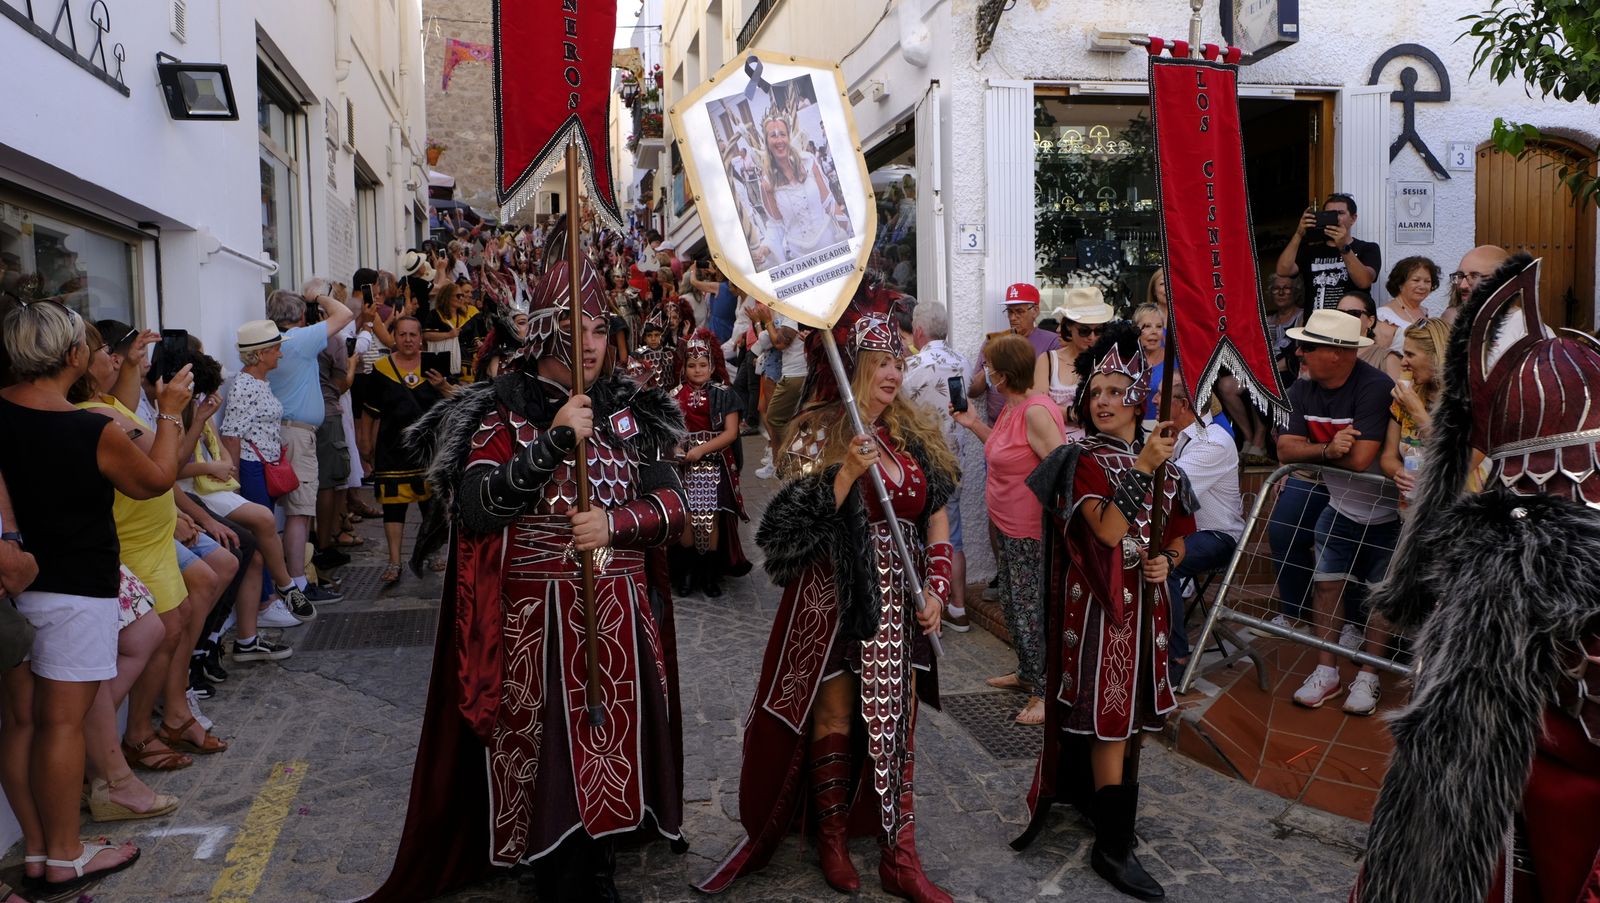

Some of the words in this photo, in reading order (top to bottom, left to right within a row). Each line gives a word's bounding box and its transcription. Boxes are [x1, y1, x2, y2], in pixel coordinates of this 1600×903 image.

[1457, 152, 1465, 165] 3
[1196, 70, 1210, 133] LOS
[1203, 160, 1228, 332] CISNEROS
[968, 233, 977, 248] 3
[770, 263, 795, 282] STACY
[796, 256, 818, 272] DAWN
[818, 244, 851, 263] READING
[776, 281, 809, 299] CISNERA
[809, 277, 815, 286] Y
[816, 263, 856, 284] GUERRERA
